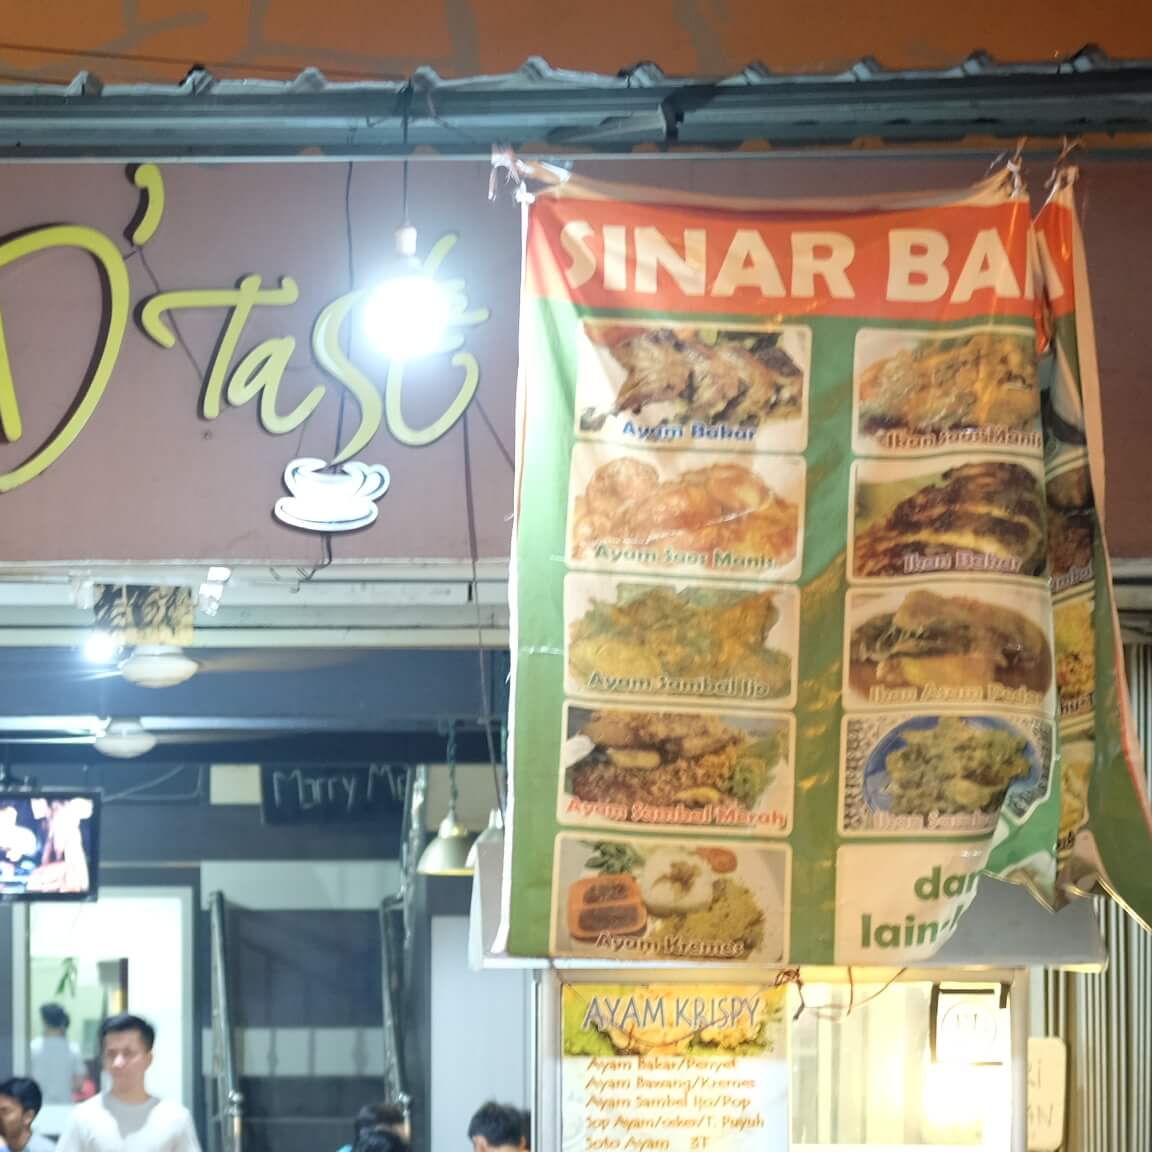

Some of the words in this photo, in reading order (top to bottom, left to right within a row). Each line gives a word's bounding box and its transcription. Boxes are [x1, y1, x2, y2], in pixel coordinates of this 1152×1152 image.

[560, 220, 855, 300] SINAR
[622, 420, 684, 440] Ayam
[595, 544, 656, 562] Ayam
[588, 671, 653, 690] Ayam
[566, 797, 629, 821] Ayam
[631, 801, 714, 825] Sambal
[717, 804, 787, 830] Merah
[595, 930, 661, 953] Ayam
[581, 996, 665, 1031] AYAM
[675, 996, 761, 1029] KRISPY
[586, 1057, 632, 1074] Ayam
[585, 1076, 631, 1093] Ayam
[585, 1095, 631, 1111] Ayam
[585, 1136, 621, 1150] Soto
[624, 1135, 670, 1152] Ayam
